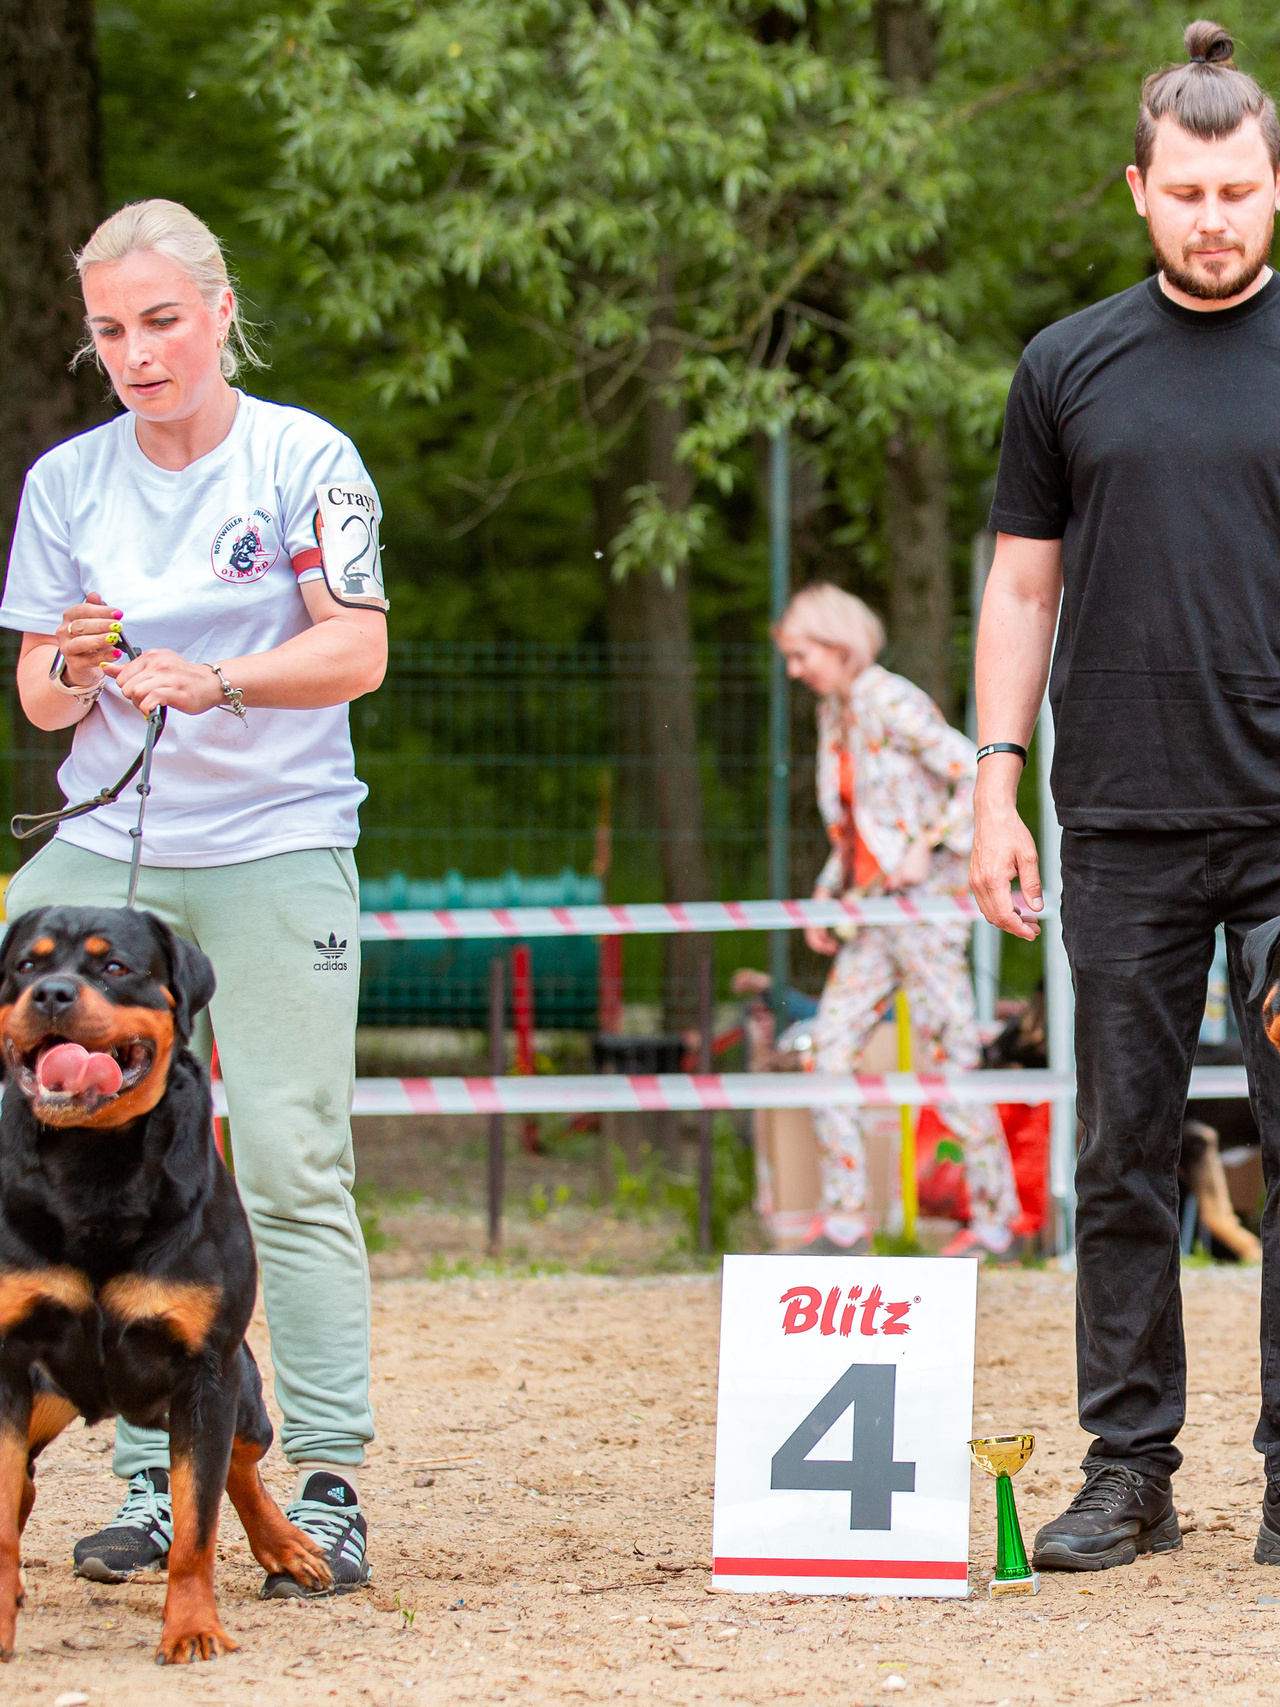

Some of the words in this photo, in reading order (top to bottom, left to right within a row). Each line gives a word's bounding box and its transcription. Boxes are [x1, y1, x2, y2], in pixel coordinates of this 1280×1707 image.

[213, 517, 244, 555] ROTTWEILER
[221, 560, 269, 579] OLBURD
[313, 960, 348, 971] adidas
[770, 1363, 917, 1531] 4
